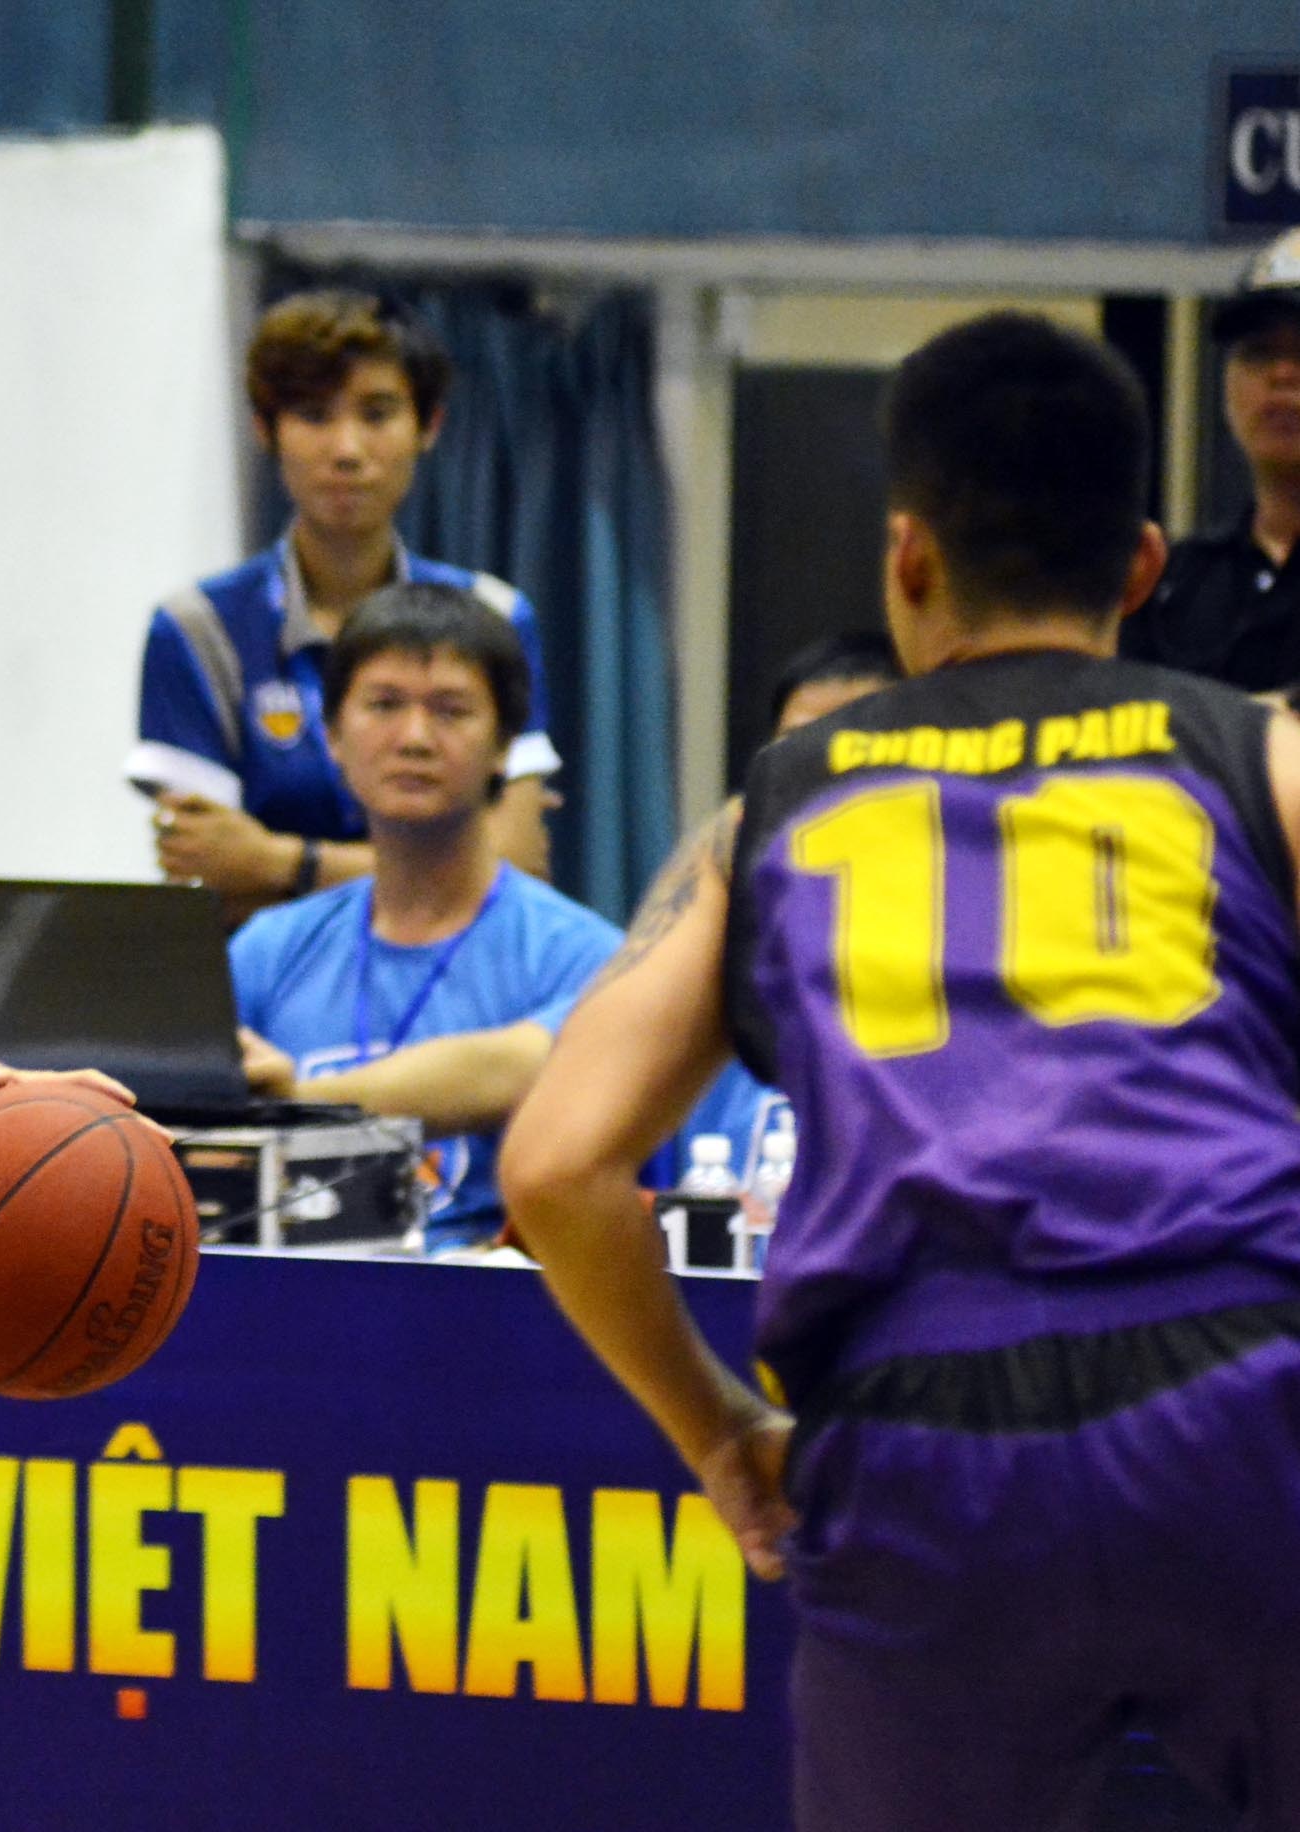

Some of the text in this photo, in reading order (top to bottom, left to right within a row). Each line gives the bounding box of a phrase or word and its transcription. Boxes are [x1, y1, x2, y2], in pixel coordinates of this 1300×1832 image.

[828, 700, 1177, 776] CHONG PAUL
[791, 775, 1222, 1059] 10
[58, 1218, 176, 1388] ALDING
[346, 1473, 747, 1713] NAM
